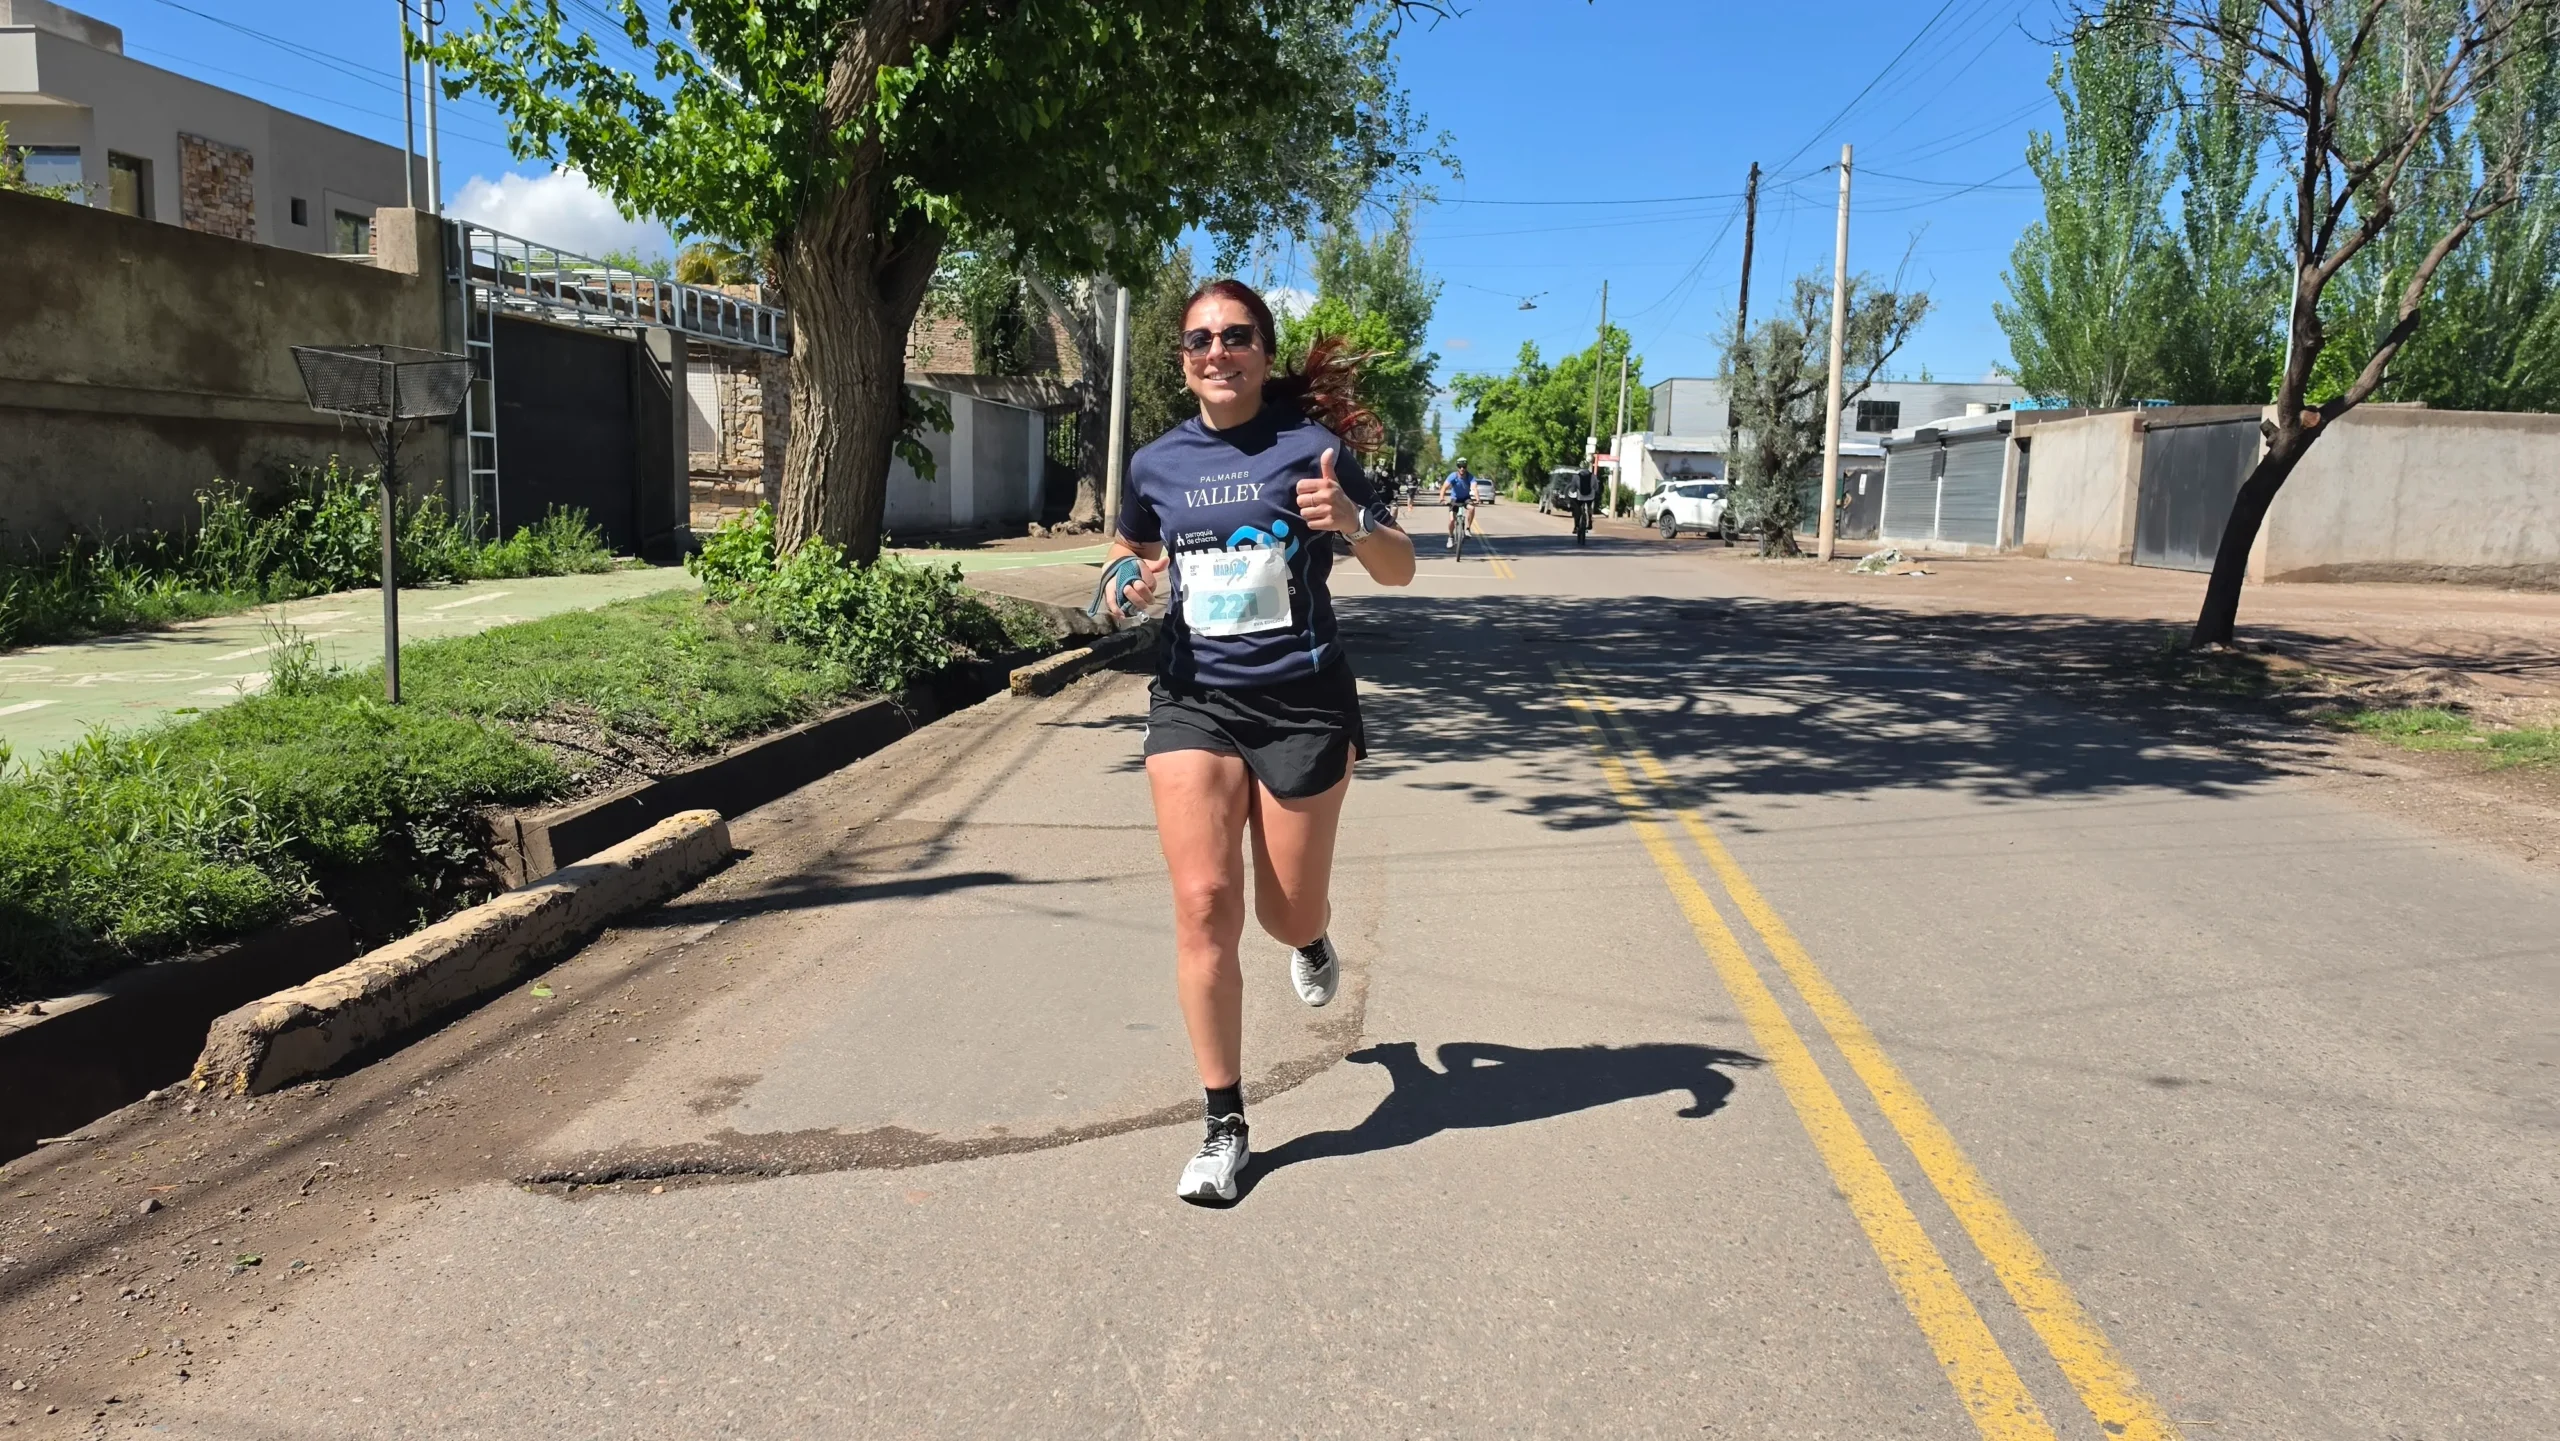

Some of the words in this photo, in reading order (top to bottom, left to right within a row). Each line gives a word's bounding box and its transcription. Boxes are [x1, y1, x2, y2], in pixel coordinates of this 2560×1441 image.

[1200, 471, 1249, 483] PALMARES
[1184, 483, 1265, 508] VALLEY
[1185, 529, 1213, 539] parroquia
[1195, 536, 1218, 544] chacras
[1208, 592, 1258, 620] 221
